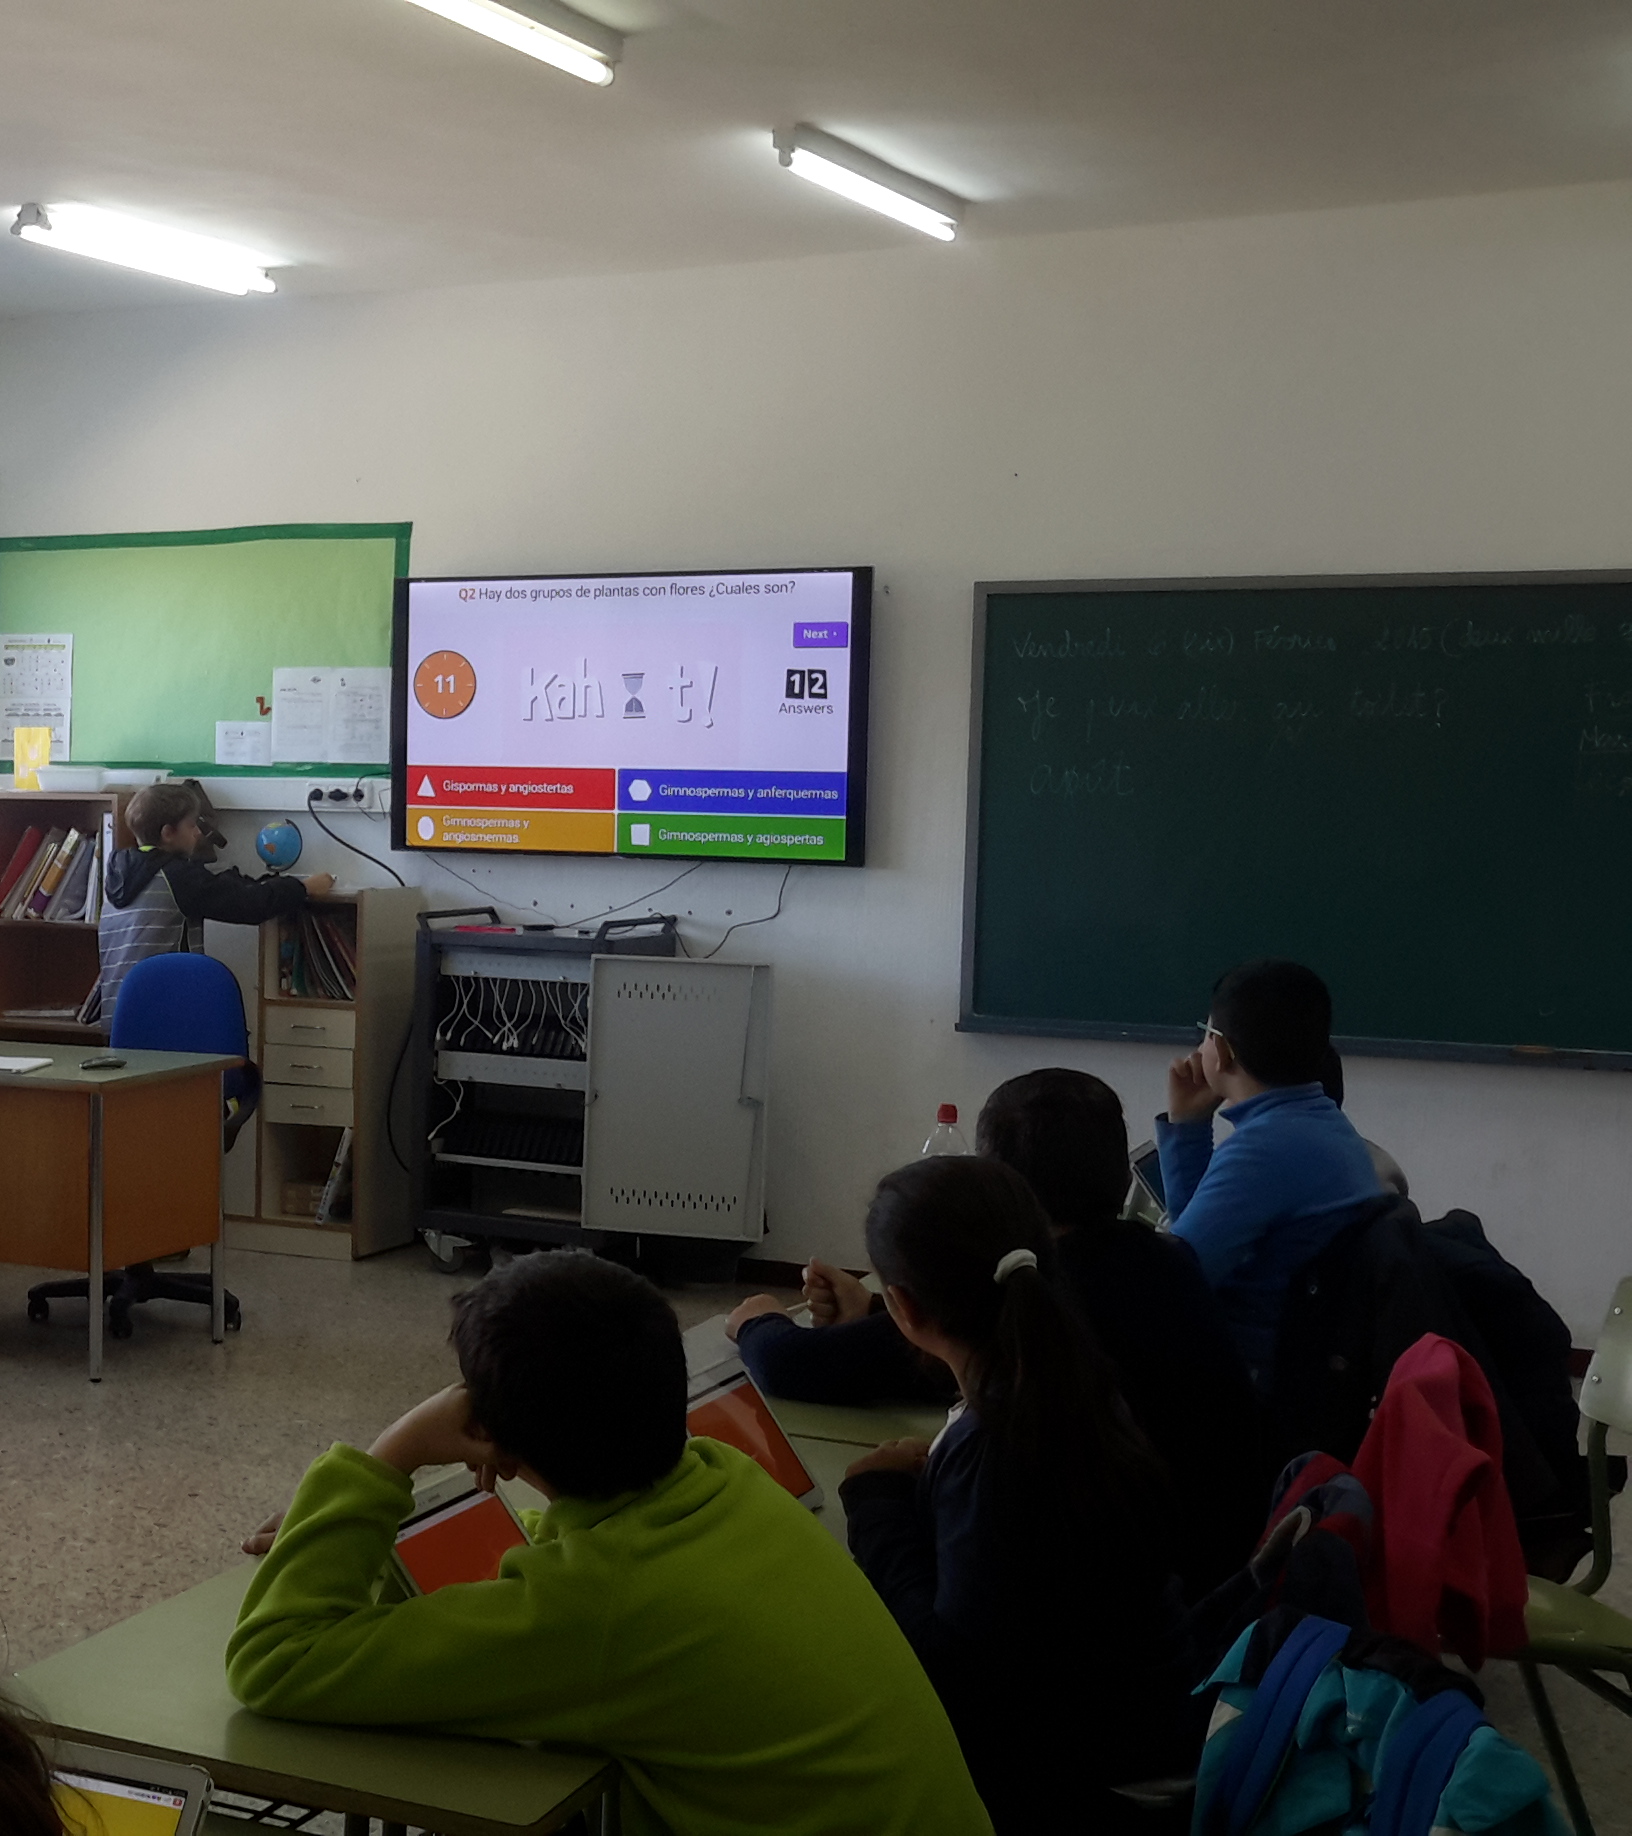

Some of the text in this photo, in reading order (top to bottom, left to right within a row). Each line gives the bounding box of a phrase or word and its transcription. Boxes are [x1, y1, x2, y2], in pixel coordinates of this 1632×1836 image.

[459, 581, 796, 602] Q2 Hay dos grupos de plantas con flores ¿Cuales son?
[803, 628, 828, 639] Next
[433, 674, 455, 694] 11
[789, 672, 826, 694] 12
[779, 702, 834, 715] Answers
[501, 783, 508, 795] y
[659, 784, 745, 799] Gimnospermas
[748, 788, 754, 800] y
[443, 815, 530, 830] Gimnospermas y
[658, 829, 744, 844] Gimnospermas
[747, 833, 754, 846] y
